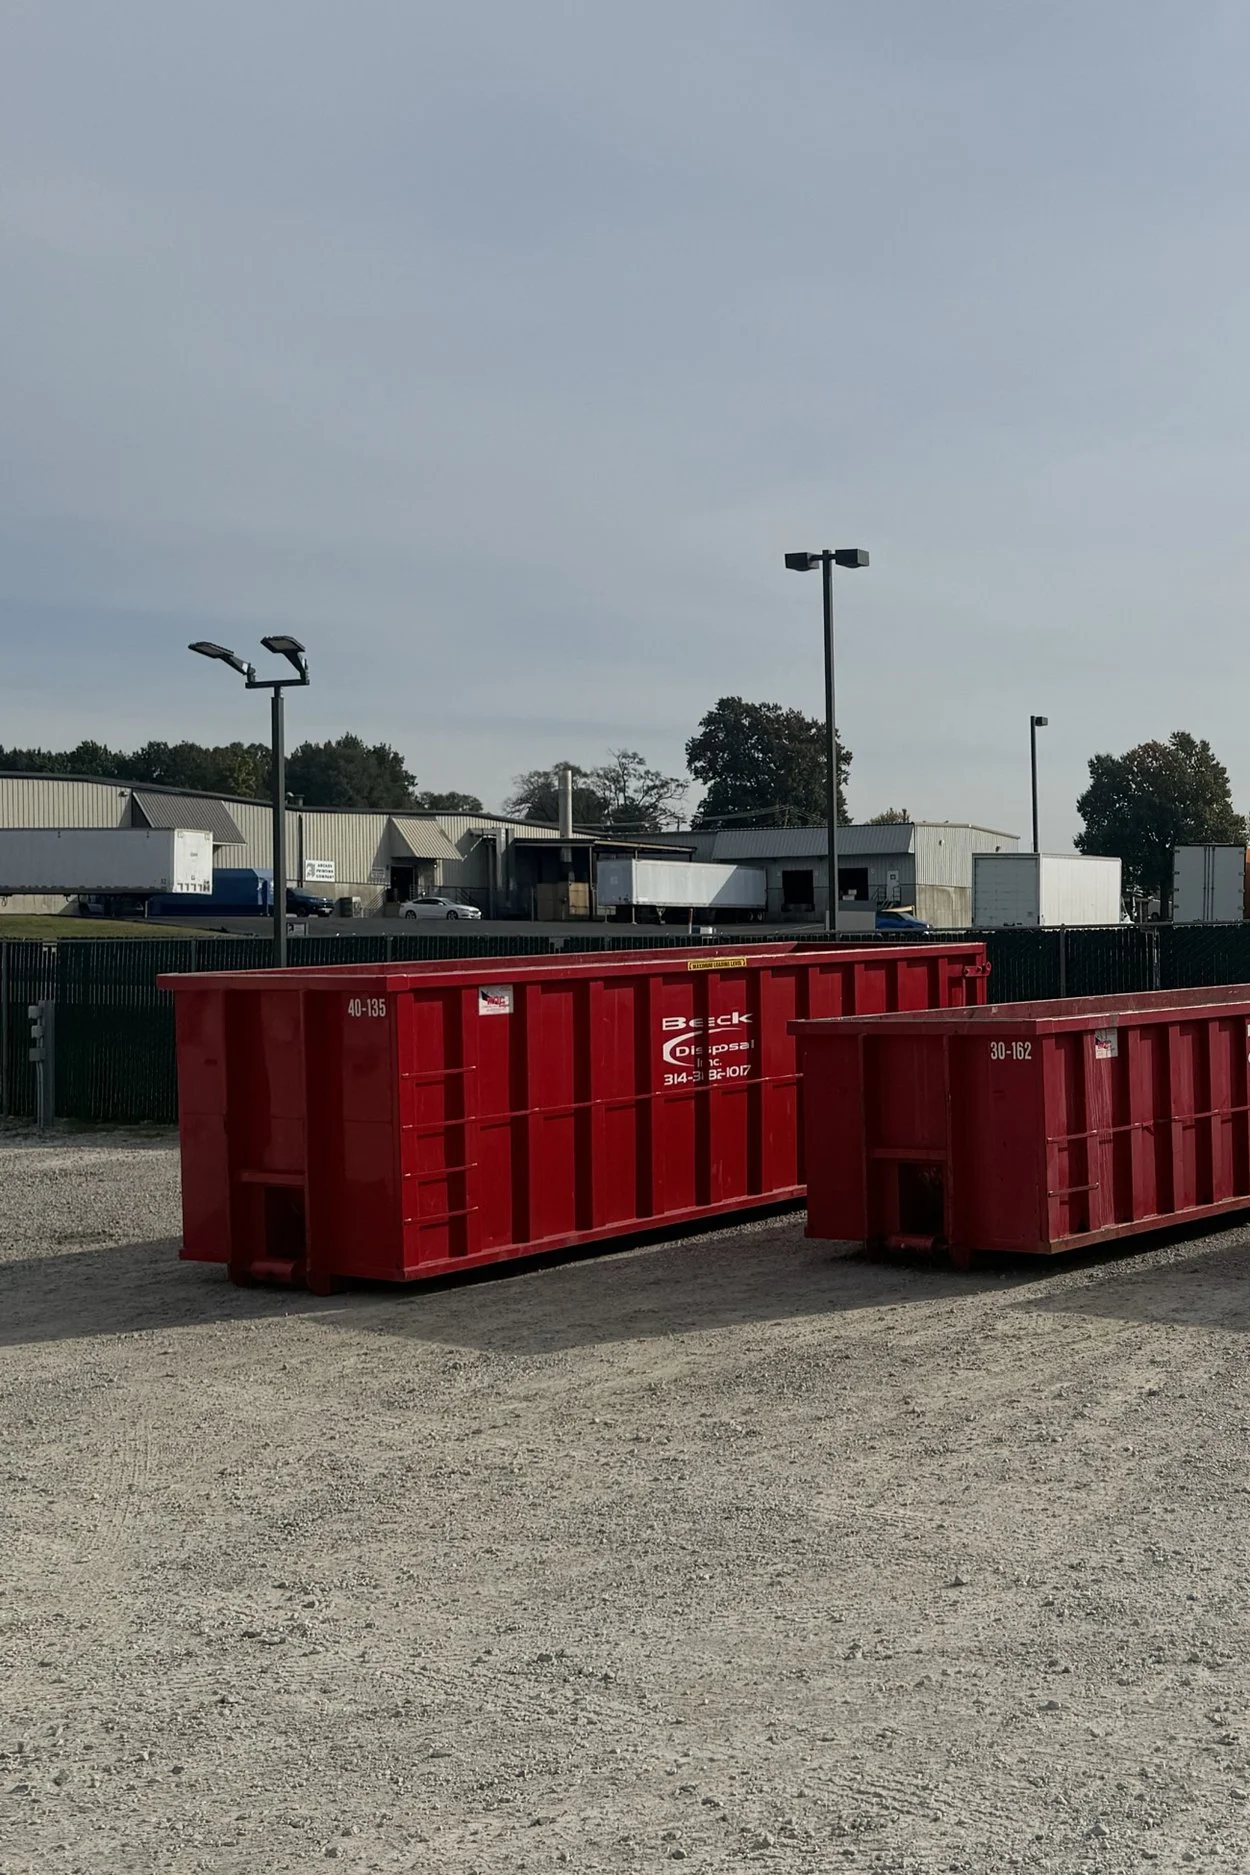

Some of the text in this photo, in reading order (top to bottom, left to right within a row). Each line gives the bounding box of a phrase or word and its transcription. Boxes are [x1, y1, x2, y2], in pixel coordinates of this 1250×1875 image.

[348, 998, 386, 1017] 40-135
[662, 1011, 753, 1031] Beck
[990, 1041, 1032, 1060] 30-162
